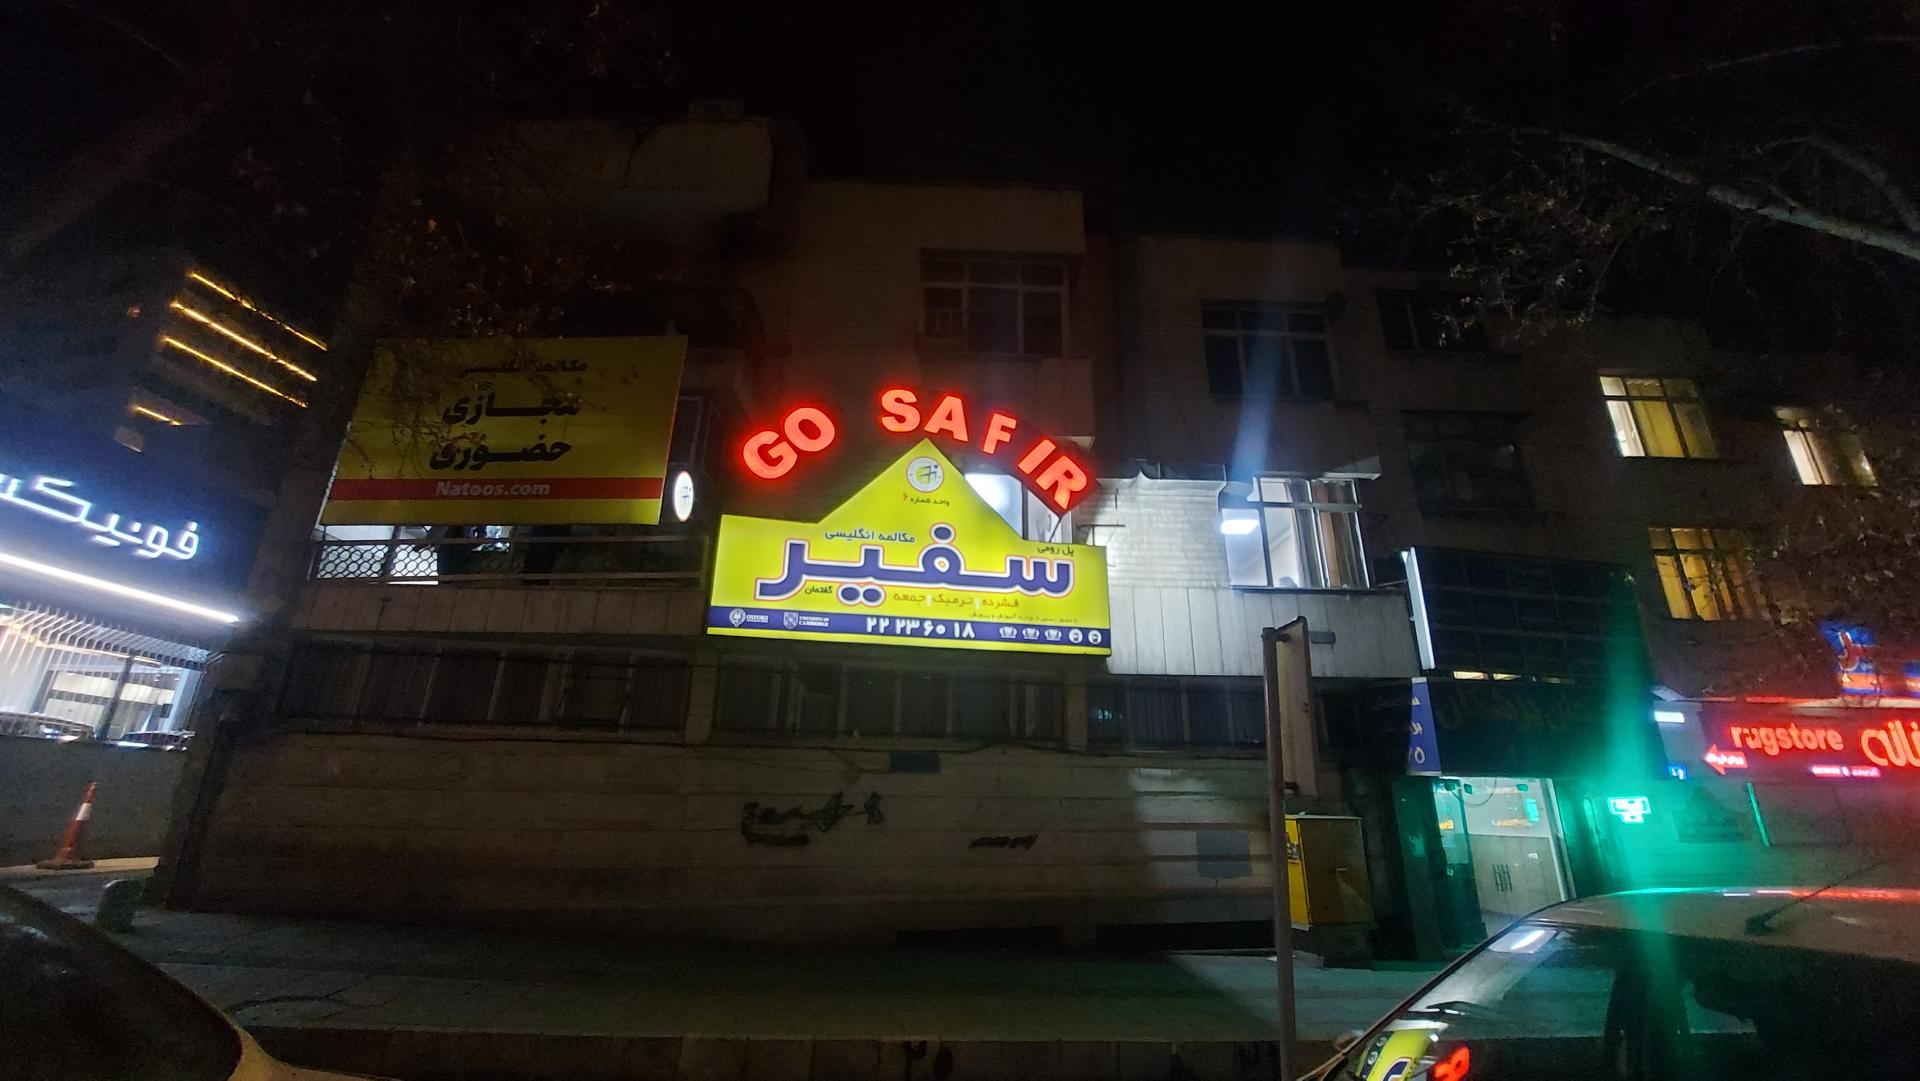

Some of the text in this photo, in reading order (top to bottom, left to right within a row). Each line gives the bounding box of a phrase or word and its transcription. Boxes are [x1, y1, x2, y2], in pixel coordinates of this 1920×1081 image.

[429, 434, 573, 471] حضوری
[742, 389, 1088, 510] GO SAFIR
[435, 480, 551, 496] Natoos.com
[825, 528, 916, 543] مکالمه انگلیسی
[754, 523, 1074, 606] سفیر
[893, 592, 1020, 609] فشرده ترمیک جمعه
